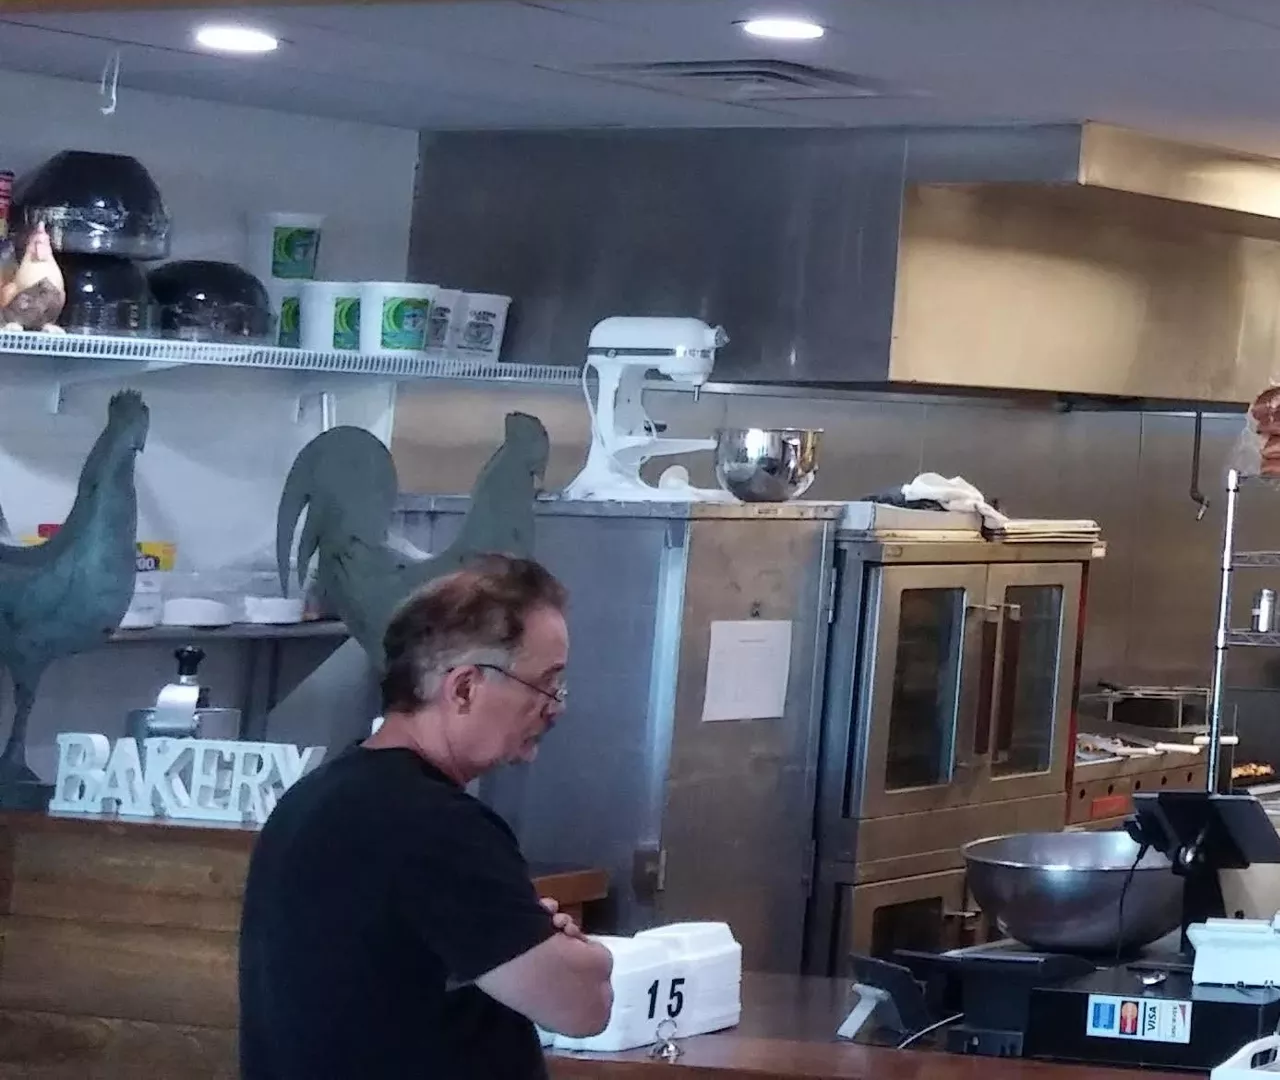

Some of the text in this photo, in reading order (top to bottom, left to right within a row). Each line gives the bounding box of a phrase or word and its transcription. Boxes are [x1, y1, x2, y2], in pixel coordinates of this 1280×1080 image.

[49, 732, 328, 824] BAKERY
[648, 978, 685, 1019] 15
[1147, 1006, 1157, 1031] VISA
